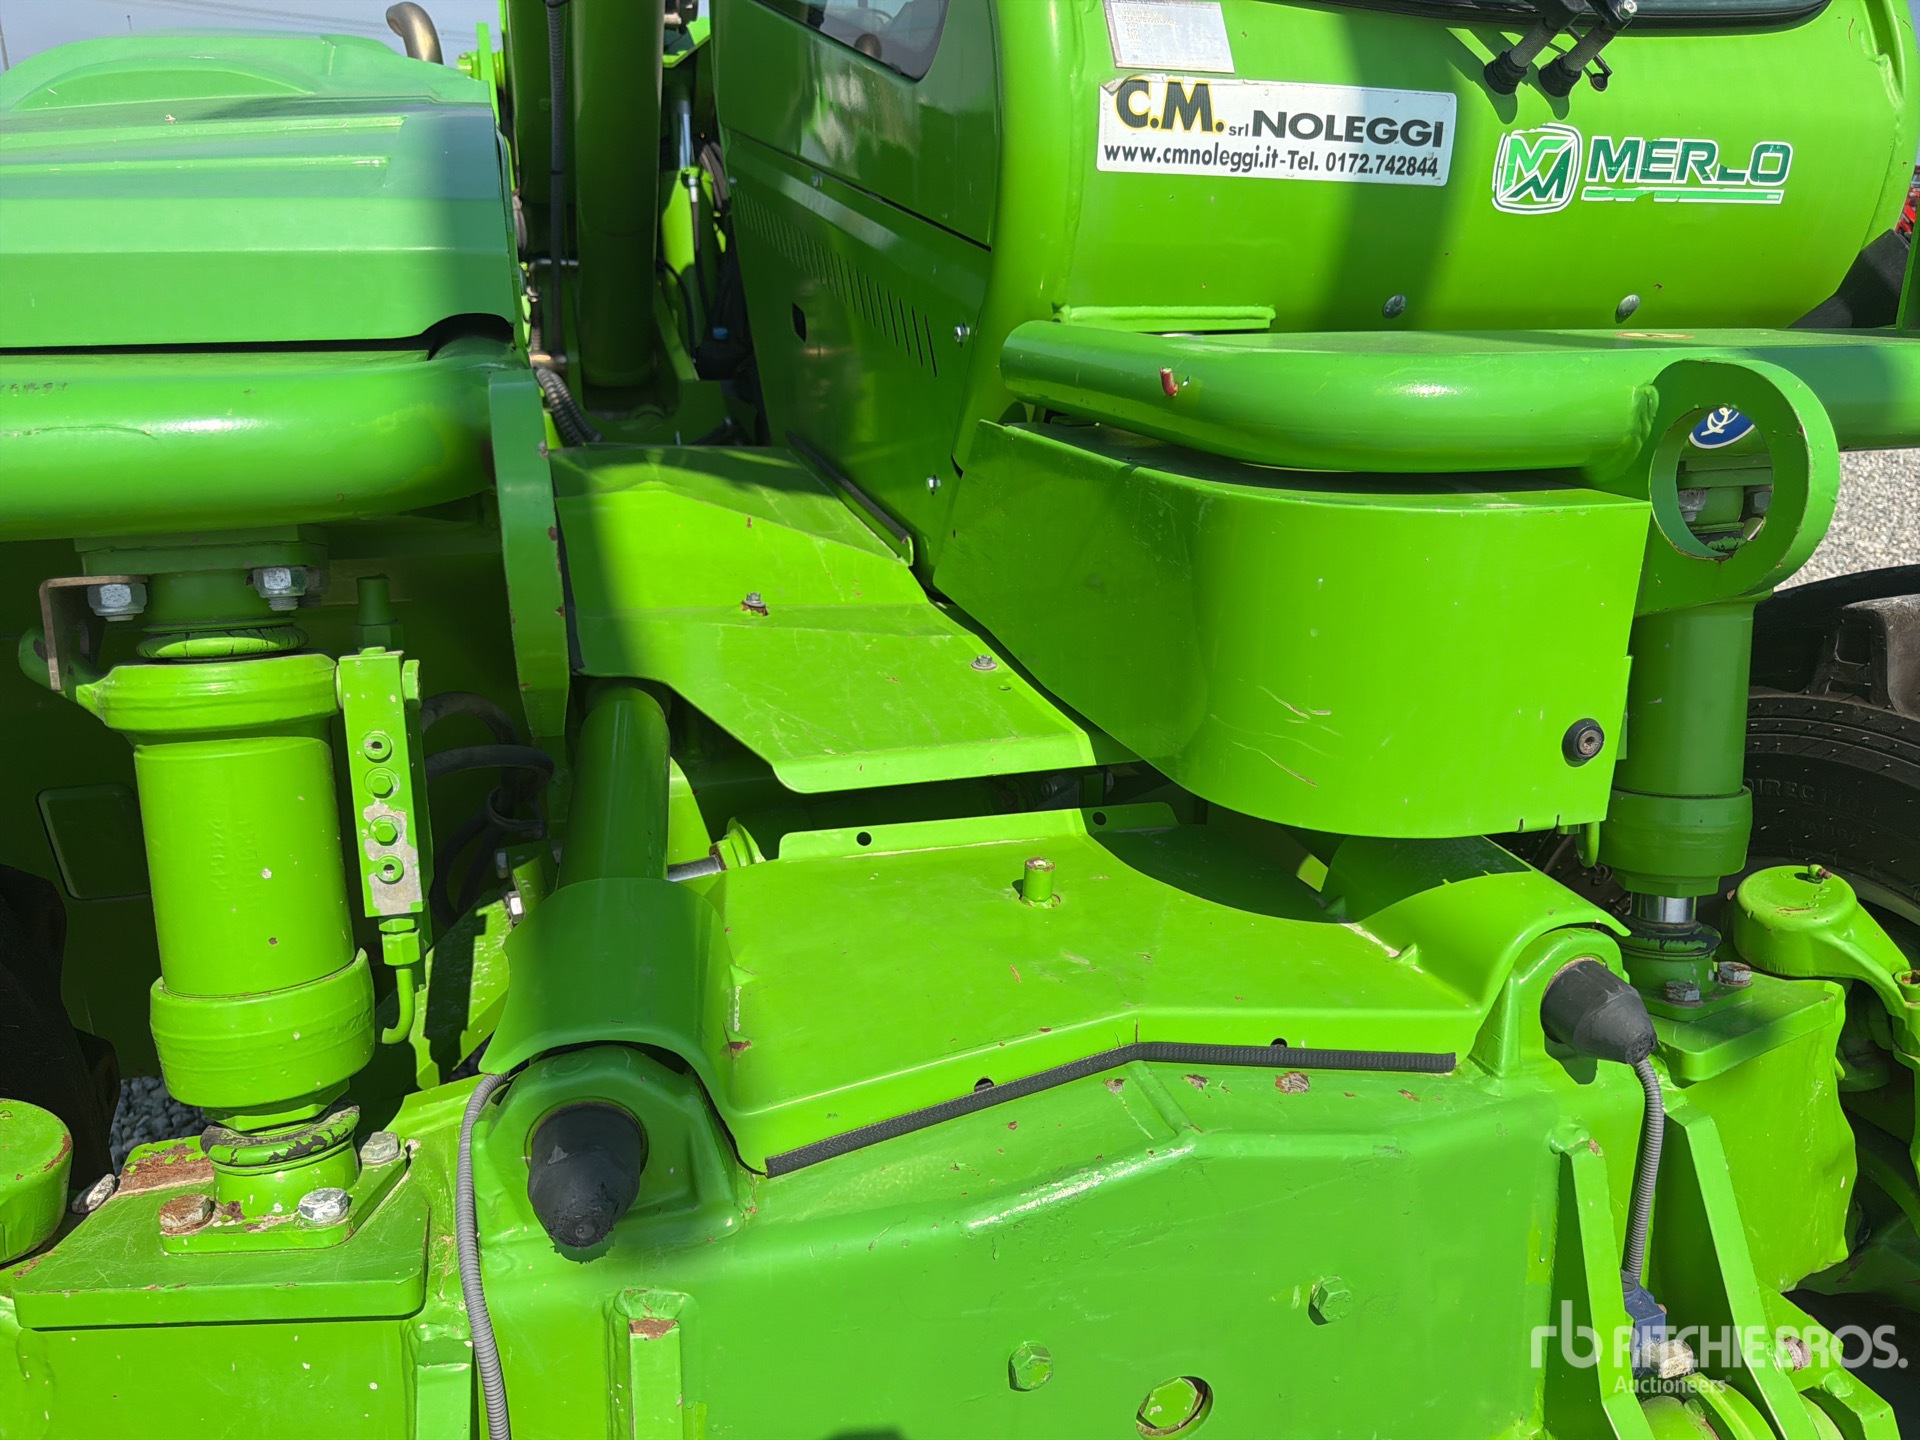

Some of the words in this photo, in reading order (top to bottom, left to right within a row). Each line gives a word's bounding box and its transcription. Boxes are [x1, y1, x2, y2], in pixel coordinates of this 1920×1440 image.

[1115, 77, 1226, 133] C.M.
[1228, 123, 1249, 137] srl
[1252, 110, 1444, 148] NOLEGGI
[1325, 151, 1438, 177] 0172.742844
[1585, 135, 1794, 187] MERLO
